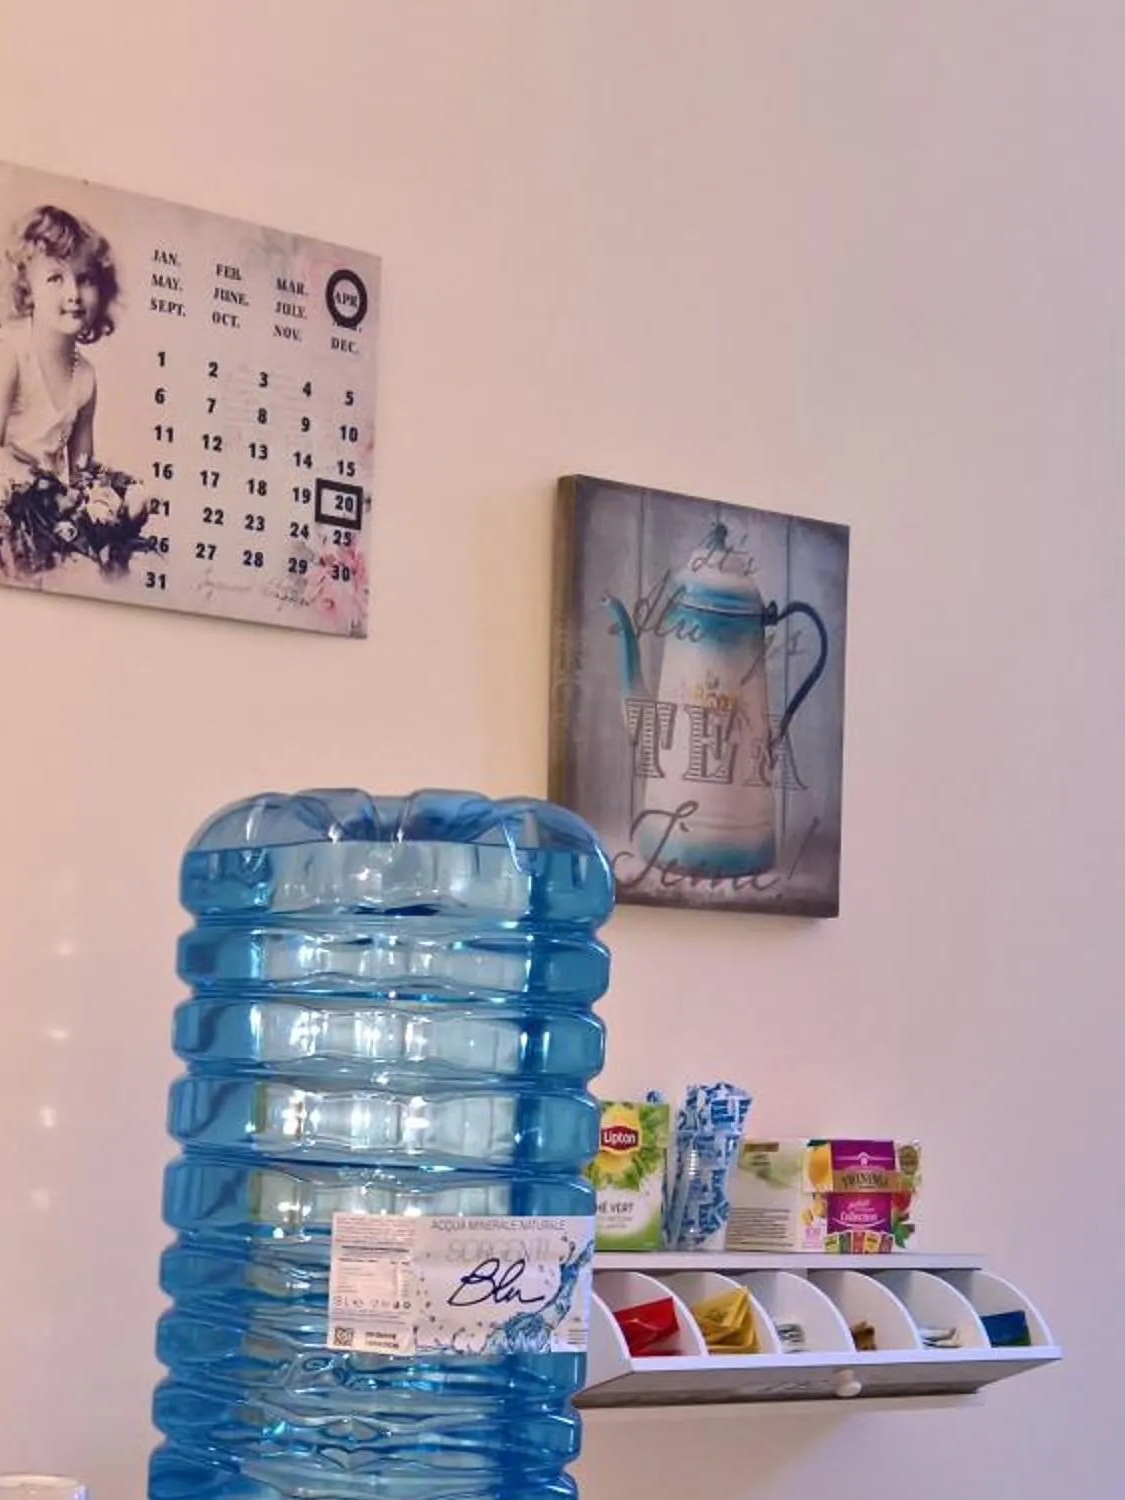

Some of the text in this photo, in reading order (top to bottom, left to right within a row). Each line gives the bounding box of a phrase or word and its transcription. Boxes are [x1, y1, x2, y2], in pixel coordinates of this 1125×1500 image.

[151, 273, 307, 319] MAY. JUNE. JULY.
[152, 250, 181, 267] JAN.
[216, 264, 242, 281] FEB.
[276, 278, 308, 296] MAR.
[150, 298, 360, 354] SEPT. OCT. NOV. DEC.
[157, 352, 355, 406] 1 2 3 4 5
[155, 388, 359, 443] 6 7 8 9 10
[154, 424, 356, 477] 11 12 13 14 15
[152, 461, 355, 512] 16 17 18 19 20
[150, 498, 353, 547] 21 22 23 24 25
[144, 571, 167, 590] 31
[150, 536, 351, 582] 26 27 28 29 30
[625, 698, 809, 791] TEA
[603, 1131, 636, 1147] Lipton
[432, 1220, 565, 1231] ACQUA MINERALE NATURALE
[610, 1202, 634, 1213] VERT
[447, 1257, 545, 1306] Blu
